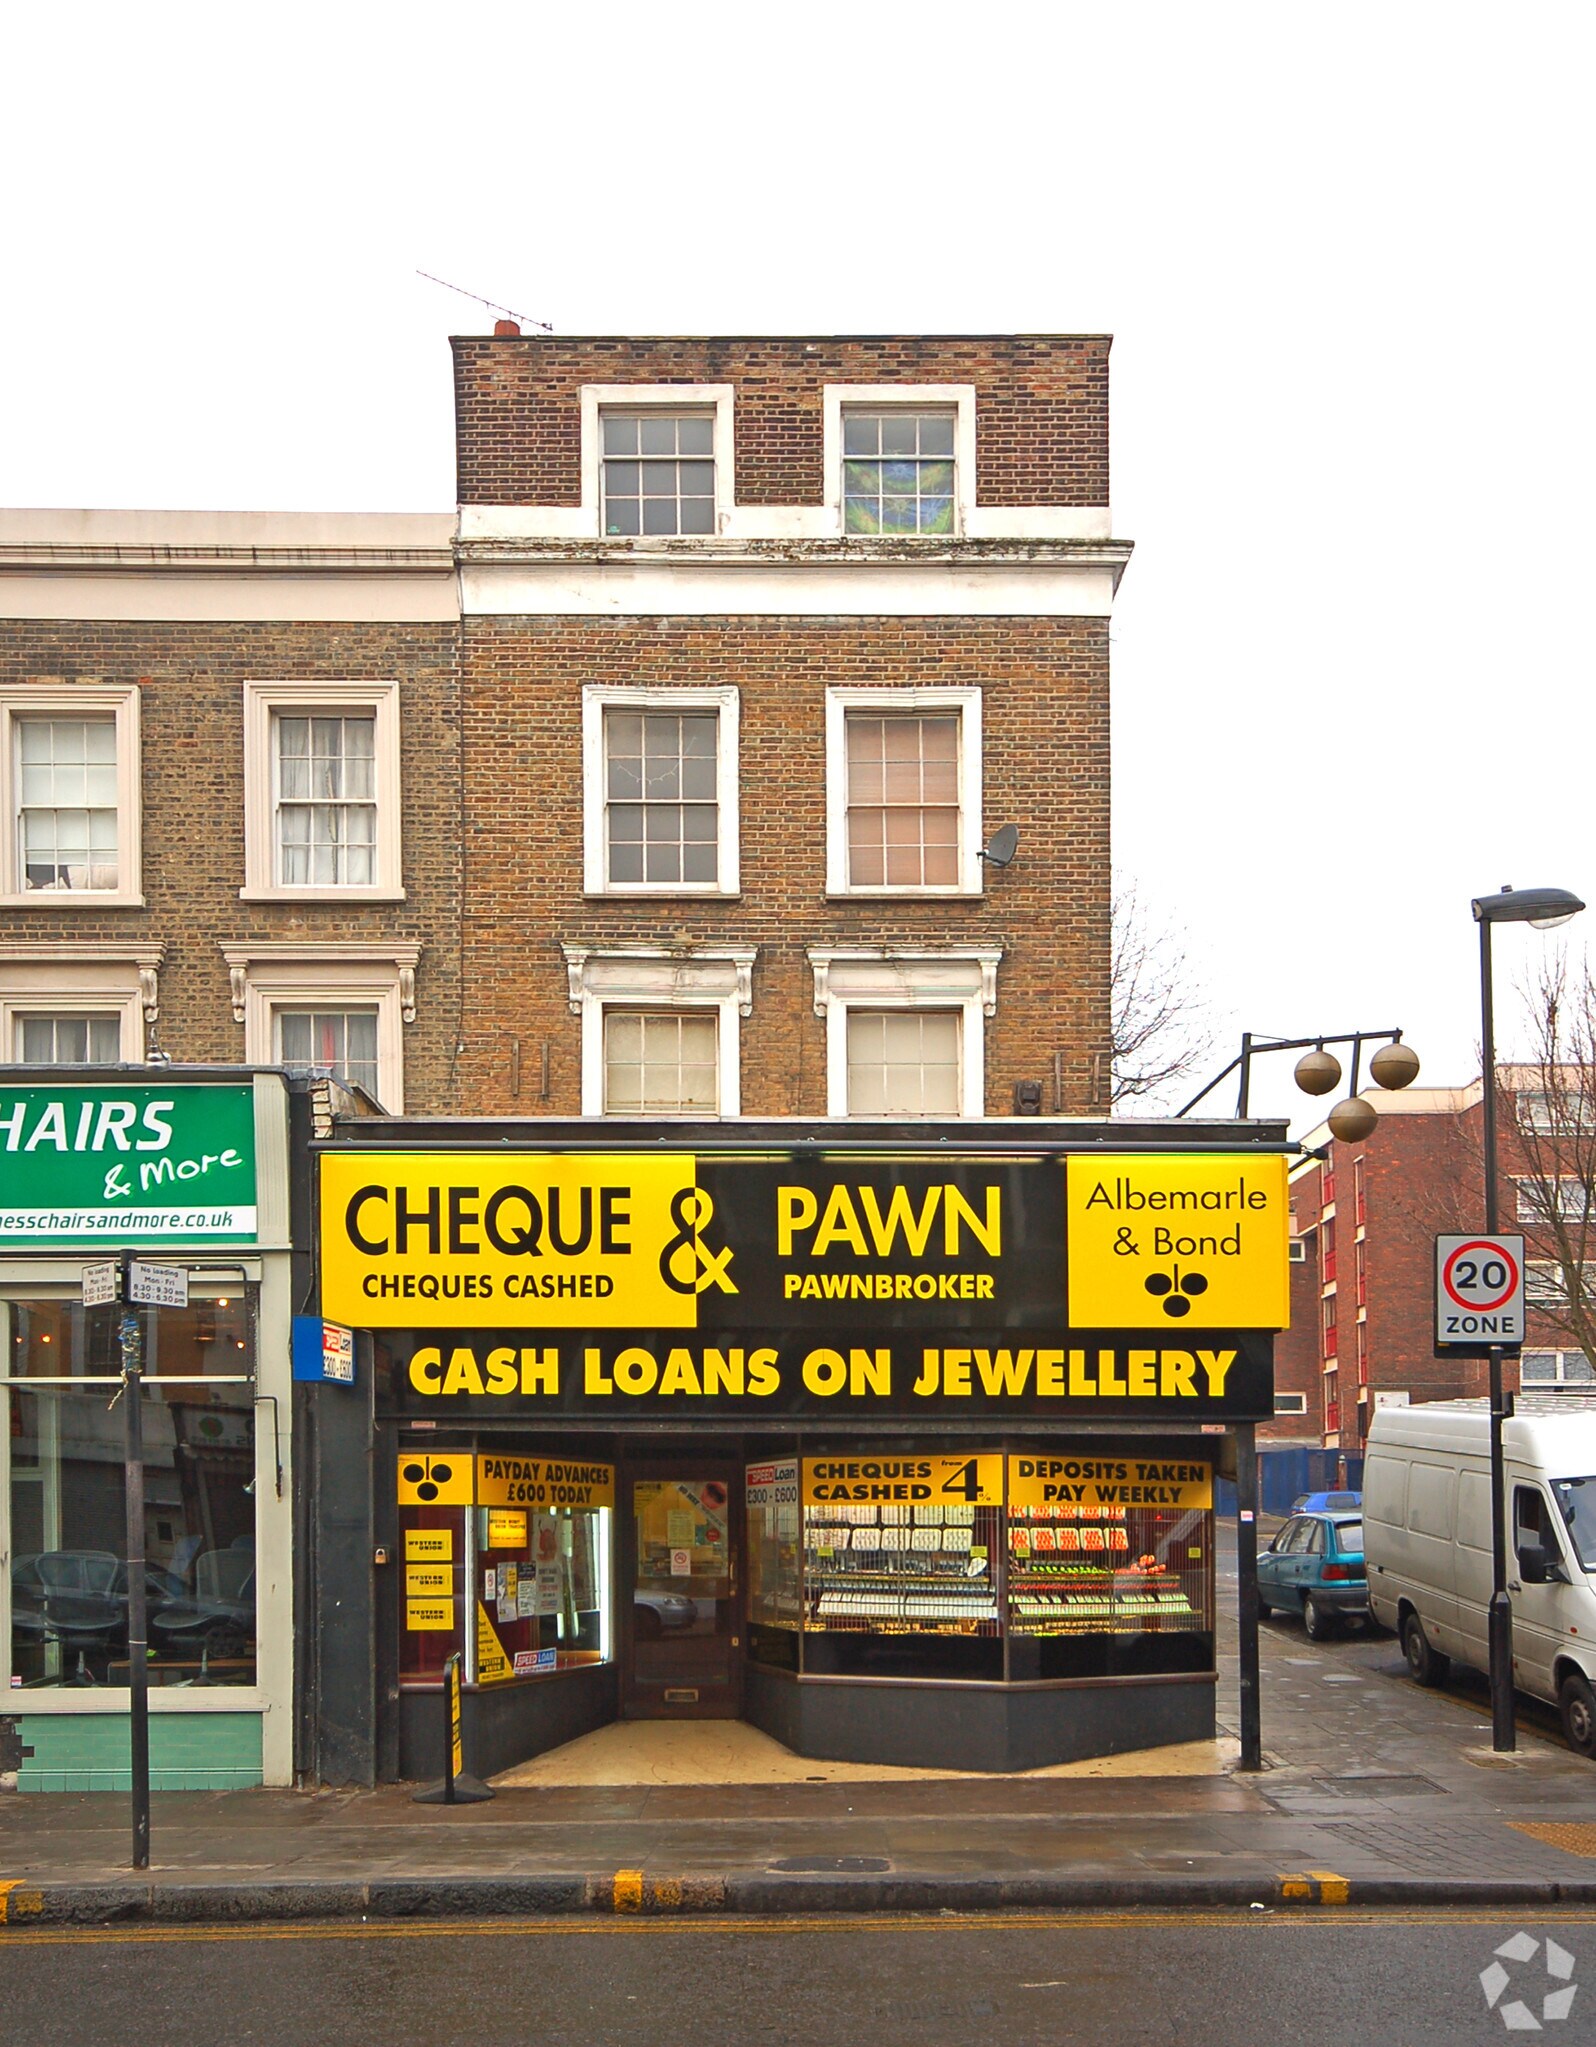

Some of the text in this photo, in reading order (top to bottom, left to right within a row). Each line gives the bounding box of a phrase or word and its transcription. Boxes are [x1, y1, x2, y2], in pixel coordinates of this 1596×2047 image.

[103, 1149, 243, 1199] & More
[1085, 1177, 1267, 1210] Albemarle
[345, 1184, 1001, 1295] CHEQUE & PAWN
[1113, 1223, 1241, 1256] & Bond
[145, 1276, 159, 1284] Mon
[153, 1267, 178, 1278] loading
[1455, 1260, 1507, 1290] 20
[362, 1274, 614, 1300] CHEQUES CASHED
[784, 1274, 995, 1299] PAWNBROKER
[1446, 1316, 1514, 1334] ZONE
[409, 1347, 1237, 1397] CASH LOANS ON JEWELLERY
[484, 1460, 609, 1485] PAYDAY ADVANCES
[774, 1467, 795, 1481] Loan
[813, 1462, 932, 1479] CHEQUES
[1018, 1460, 1204, 1482] DEPOSITS TAKEN
[507, 1483, 592, 1503] £600 TODAY
[747, 1488, 767, 1504] £300
[775, 1486, 796, 1503] £600
[812, 1484, 932, 1500] CASHED
[1043, 1484, 1182, 1503] PAY WEEKLY
[516, 1649, 555, 1666] SPEED LOAN
